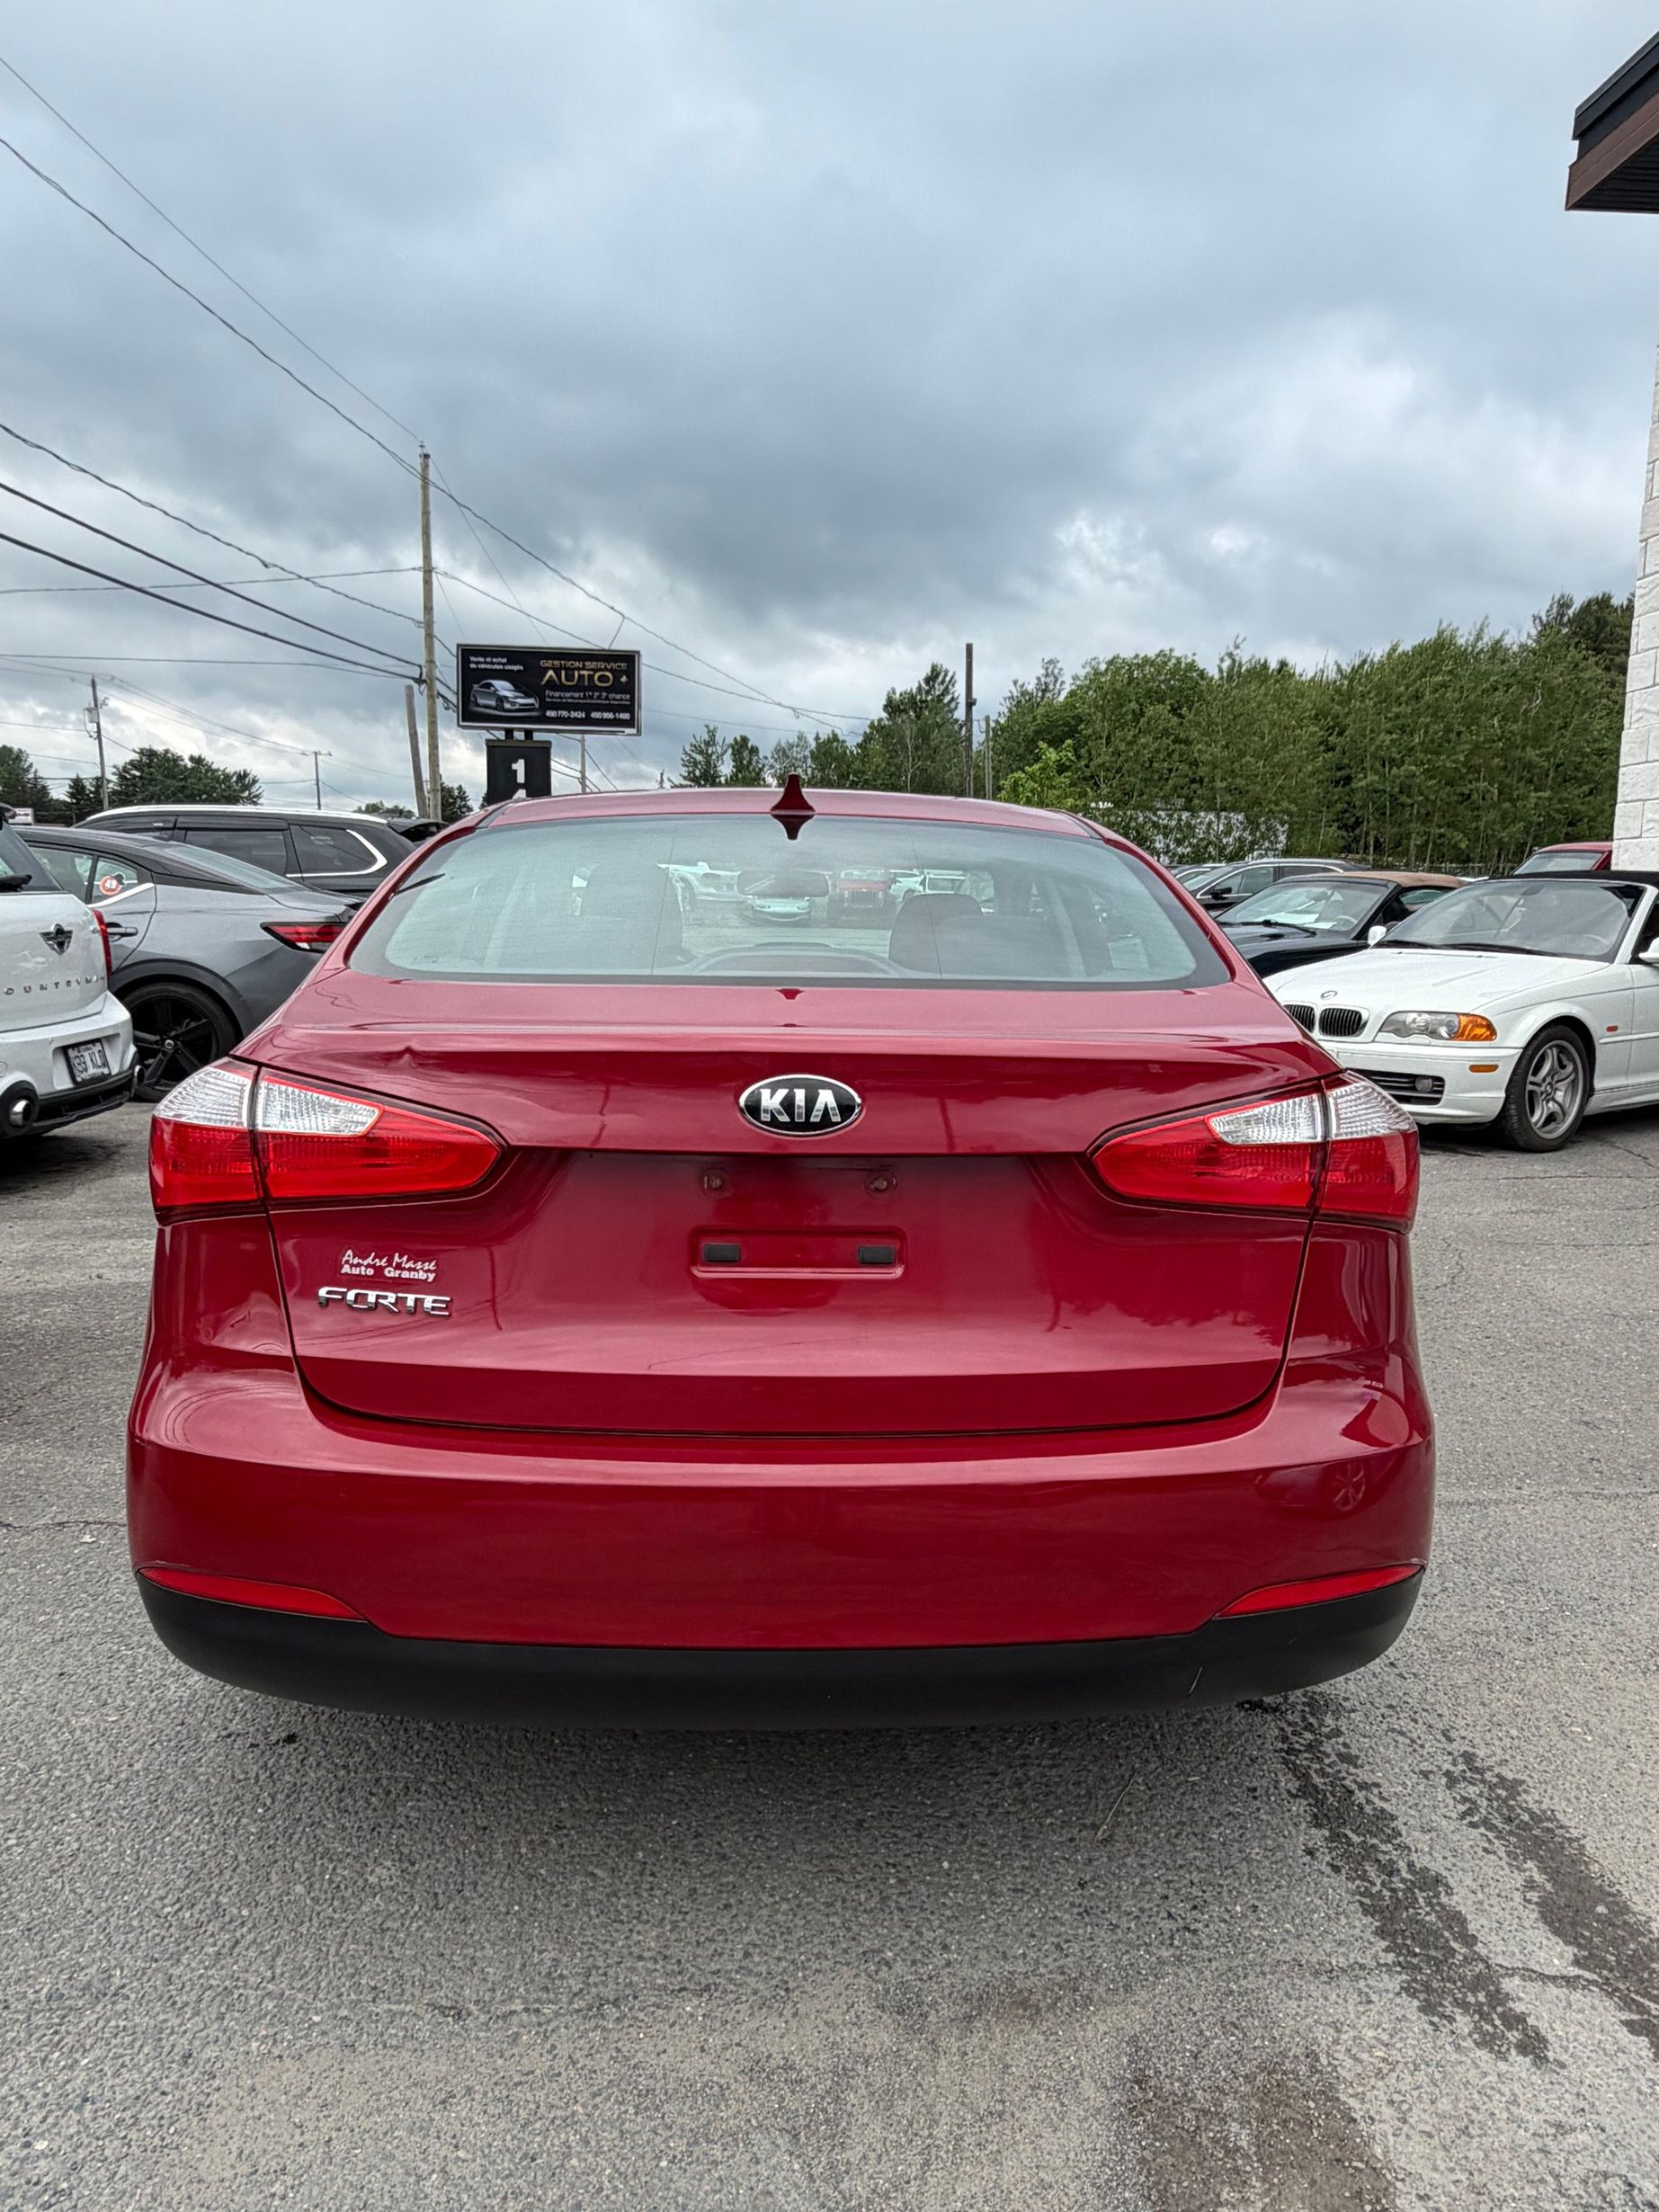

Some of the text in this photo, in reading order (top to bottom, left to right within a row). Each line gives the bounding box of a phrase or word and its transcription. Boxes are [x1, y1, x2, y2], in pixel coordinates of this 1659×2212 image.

[540, 659, 628, 670] GESTION SERVICE
[540, 669, 613, 687] AUTO
[545, 690, 584, 699] Financement
[608, 691, 630, 700] chance
[512, 759, 525, 783] 1
[760, 1088, 842, 1122] KIA
[341, 1249, 437, 1271] André Massé
[341, 1263, 436, 1282] Auto Granby
[318, 1286, 450, 1316] FORTE
